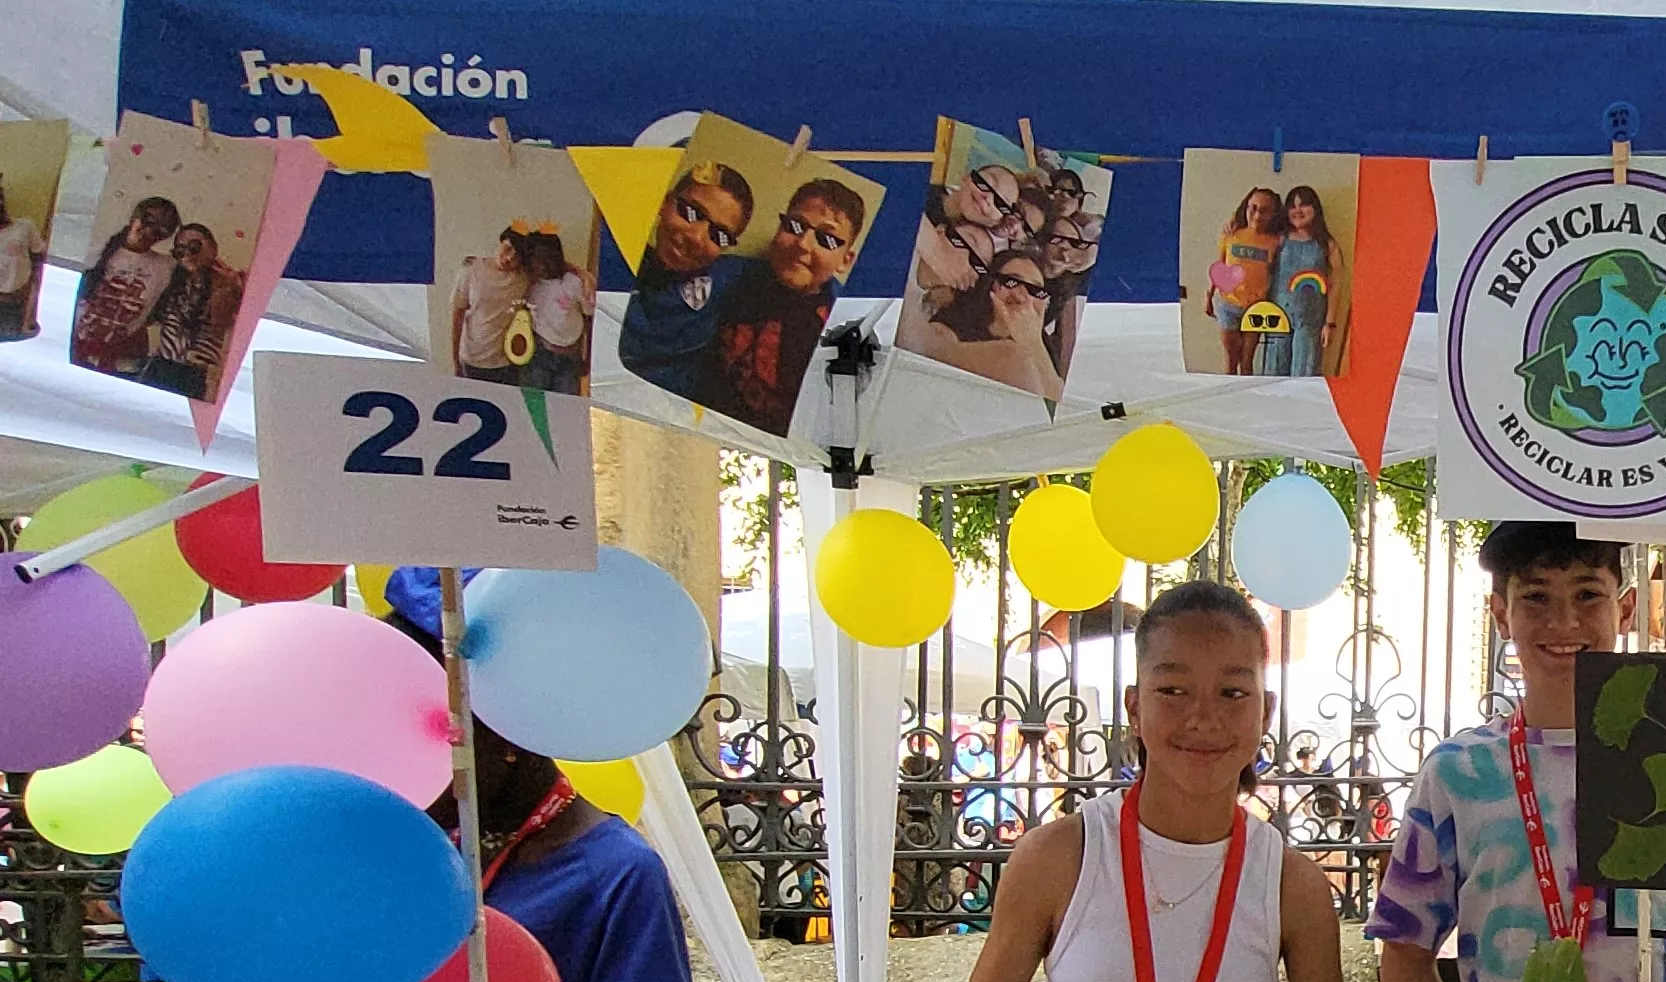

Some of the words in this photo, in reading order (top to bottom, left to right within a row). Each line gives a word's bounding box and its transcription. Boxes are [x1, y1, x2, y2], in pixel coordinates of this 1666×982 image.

[1488, 202, 1643, 308] RECICLA
[342, 390, 512, 481] 22
[1498, 411, 1614, 488] RECICLAR
[1622, 464, 1656, 488] ES
